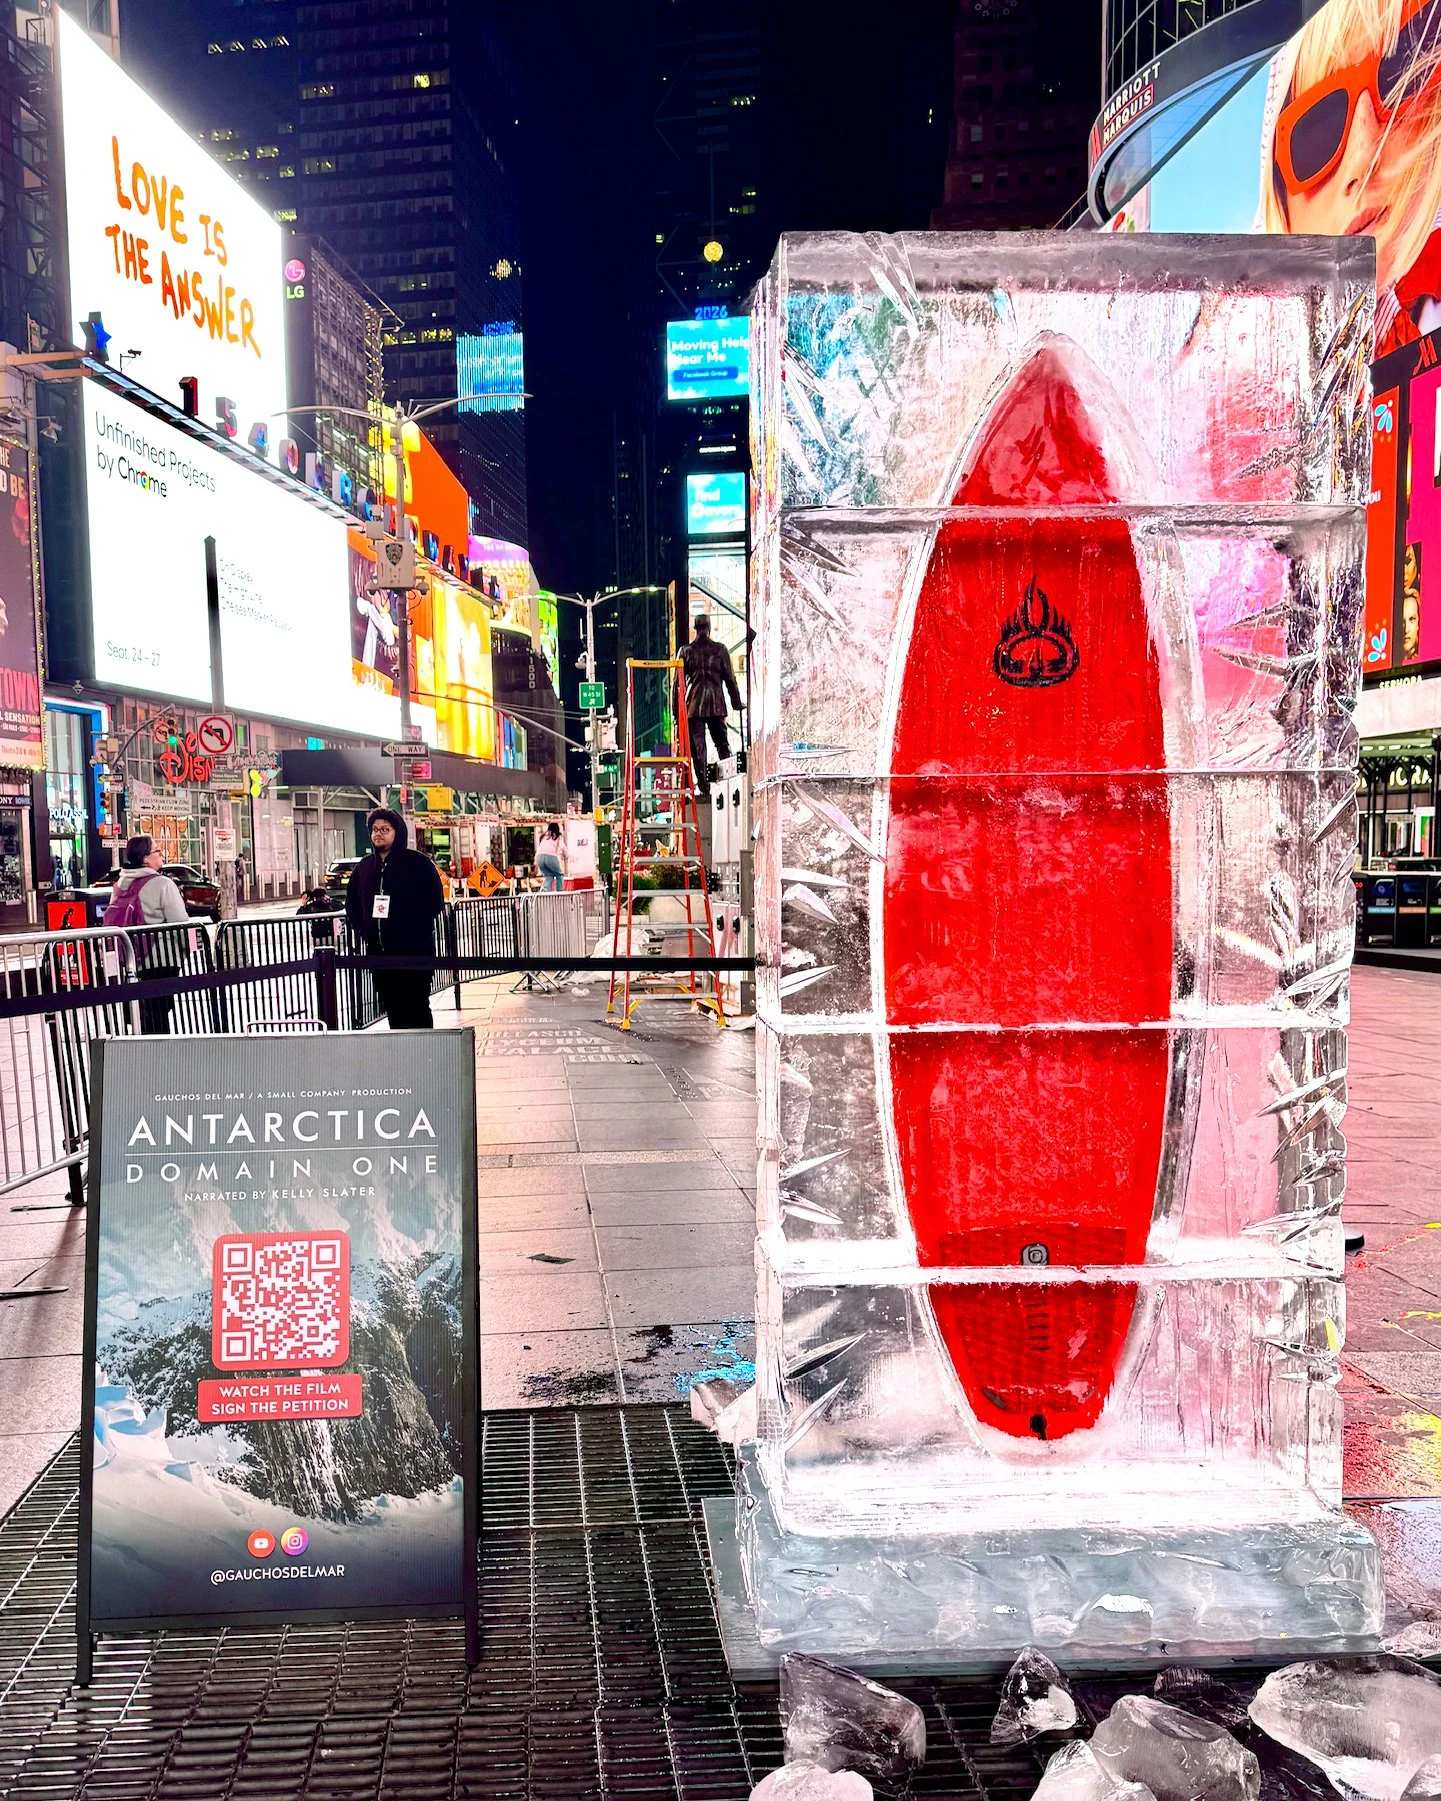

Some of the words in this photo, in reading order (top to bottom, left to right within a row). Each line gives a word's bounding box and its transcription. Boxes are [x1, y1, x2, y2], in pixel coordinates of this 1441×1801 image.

[1103, 61, 1161, 126] MARRIOTT
[1103, 89, 1151, 145] MARQUIS
[111, 135, 188, 244] LOVE
[199, 214, 228, 266] IS
[105, 224, 153, 284] THE
[161, 250, 262, 359] ANSWER
[286, 286, 305, 299] LG
[695, 305, 728, 320] 2026
[671, 339, 719, 352] Moving
[706, 352, 727, 363] Me
[96, 411, 166, 468] Unfinished
[169, 450, 216, 492] Projects
[97, 444, 114, 479] by
[117, 456, 167, 498] Chrome
[10, 473, 25, 500] BE
[107, 641, 130, 661] Sept.
[132, 647, 143, 661] 24
[151, 652, 161, 667] 27
[528, 657, 536, 689] 1500
[1379, 675, 1423, 690] SEPHORA
[4, 711, 40, 726] SENSATION
[388, 745, 401, 753] ONE
[408, 745, 423, 753] WAY
[486, 1038, 603, 1046] LYCEUM
[484, 1046, 622, 1055] PALACE
[154, 1094, 200, 1102] GAUCHOS
[225, 1092, 245, 1100] MAR
[267, 1091, 296, 1099] SMALL
[300, 1090, 346, 1098] COMPANY
[351, 1088, 412, 1096] PRODUCTION
[127, 1107, 437, 1147] ANTARCTICA
[126, 1159, 311, 1184] DOMAIN
[352, 1155, 437, 1176] ONE
[184, 1191, 247, 1202] NARRATED
[252, 1190, 266, 1200] BY
[272, 1188, 314, 1199] KELLY
[322, 1186, 376, 1197] SLATER
[219, 1385, 270, 1398] WATCH
[274, 1384, 302, 1396] THE
[306, 1383, 342, 1395] FILM
[211, 1402, 246, 1415] SIGN
[250, 1401, 278, 1414] THE
[282, 1399, 349, 1413] PETITION
[210, 1564, 345, 1585] @GAUCHOSDELMAR
